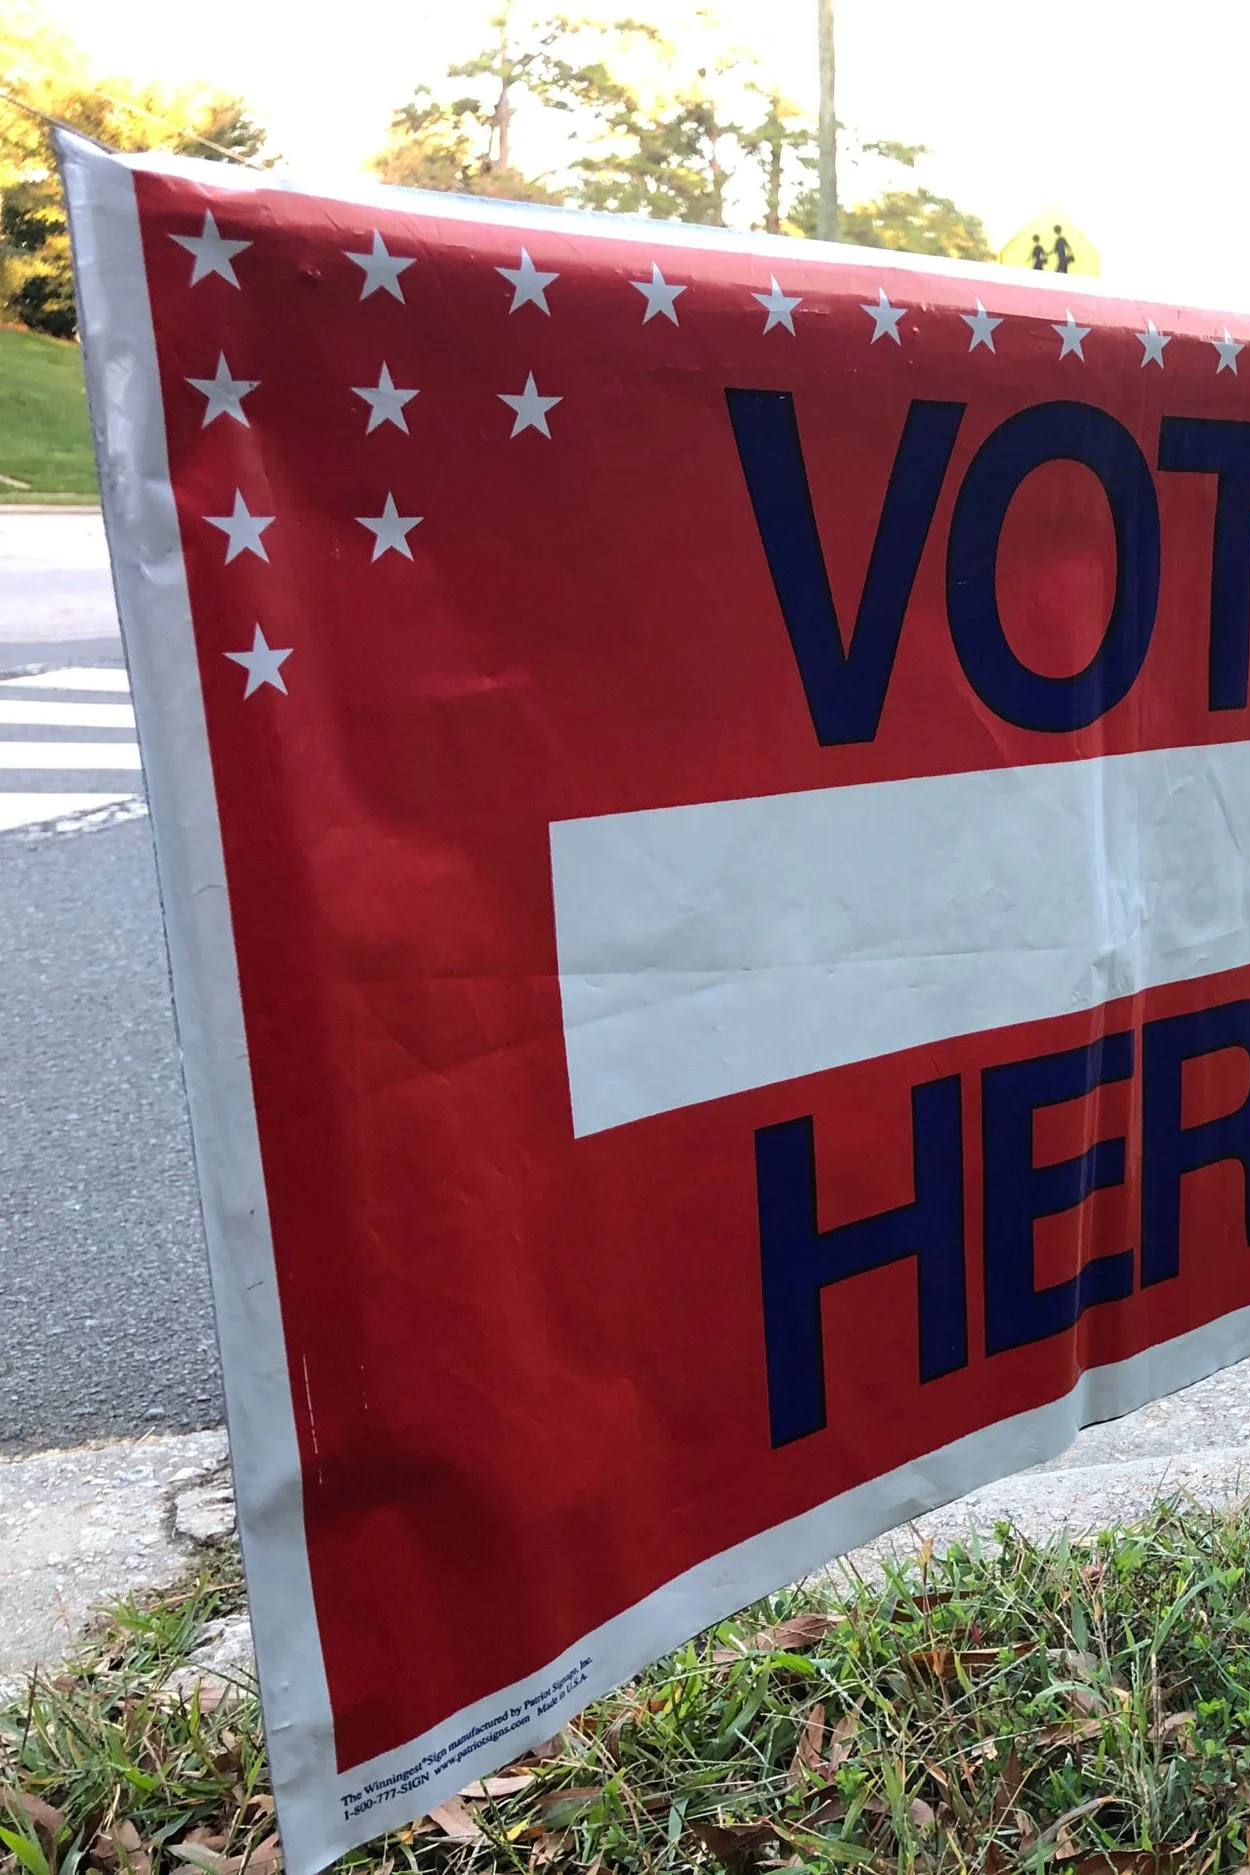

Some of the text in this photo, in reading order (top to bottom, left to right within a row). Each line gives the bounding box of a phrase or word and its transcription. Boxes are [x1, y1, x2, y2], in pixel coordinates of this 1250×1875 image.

[340, 1792, 362, 1807] The
[448, 1710, 508, 1751] manufactured
[509, 1706, 522, 1717] by
[523, 1688, 551, 1710] Patriot
[579, 1656, 593, 1669] Inc.
[344, 1770, 430, 1821] 1-800-777-SIGN
[434, 1715, 531, 1775] www.patriotsigns.com
[537, 1697, 558, 1716] Made
[559, 1690, 566, 1700] in
